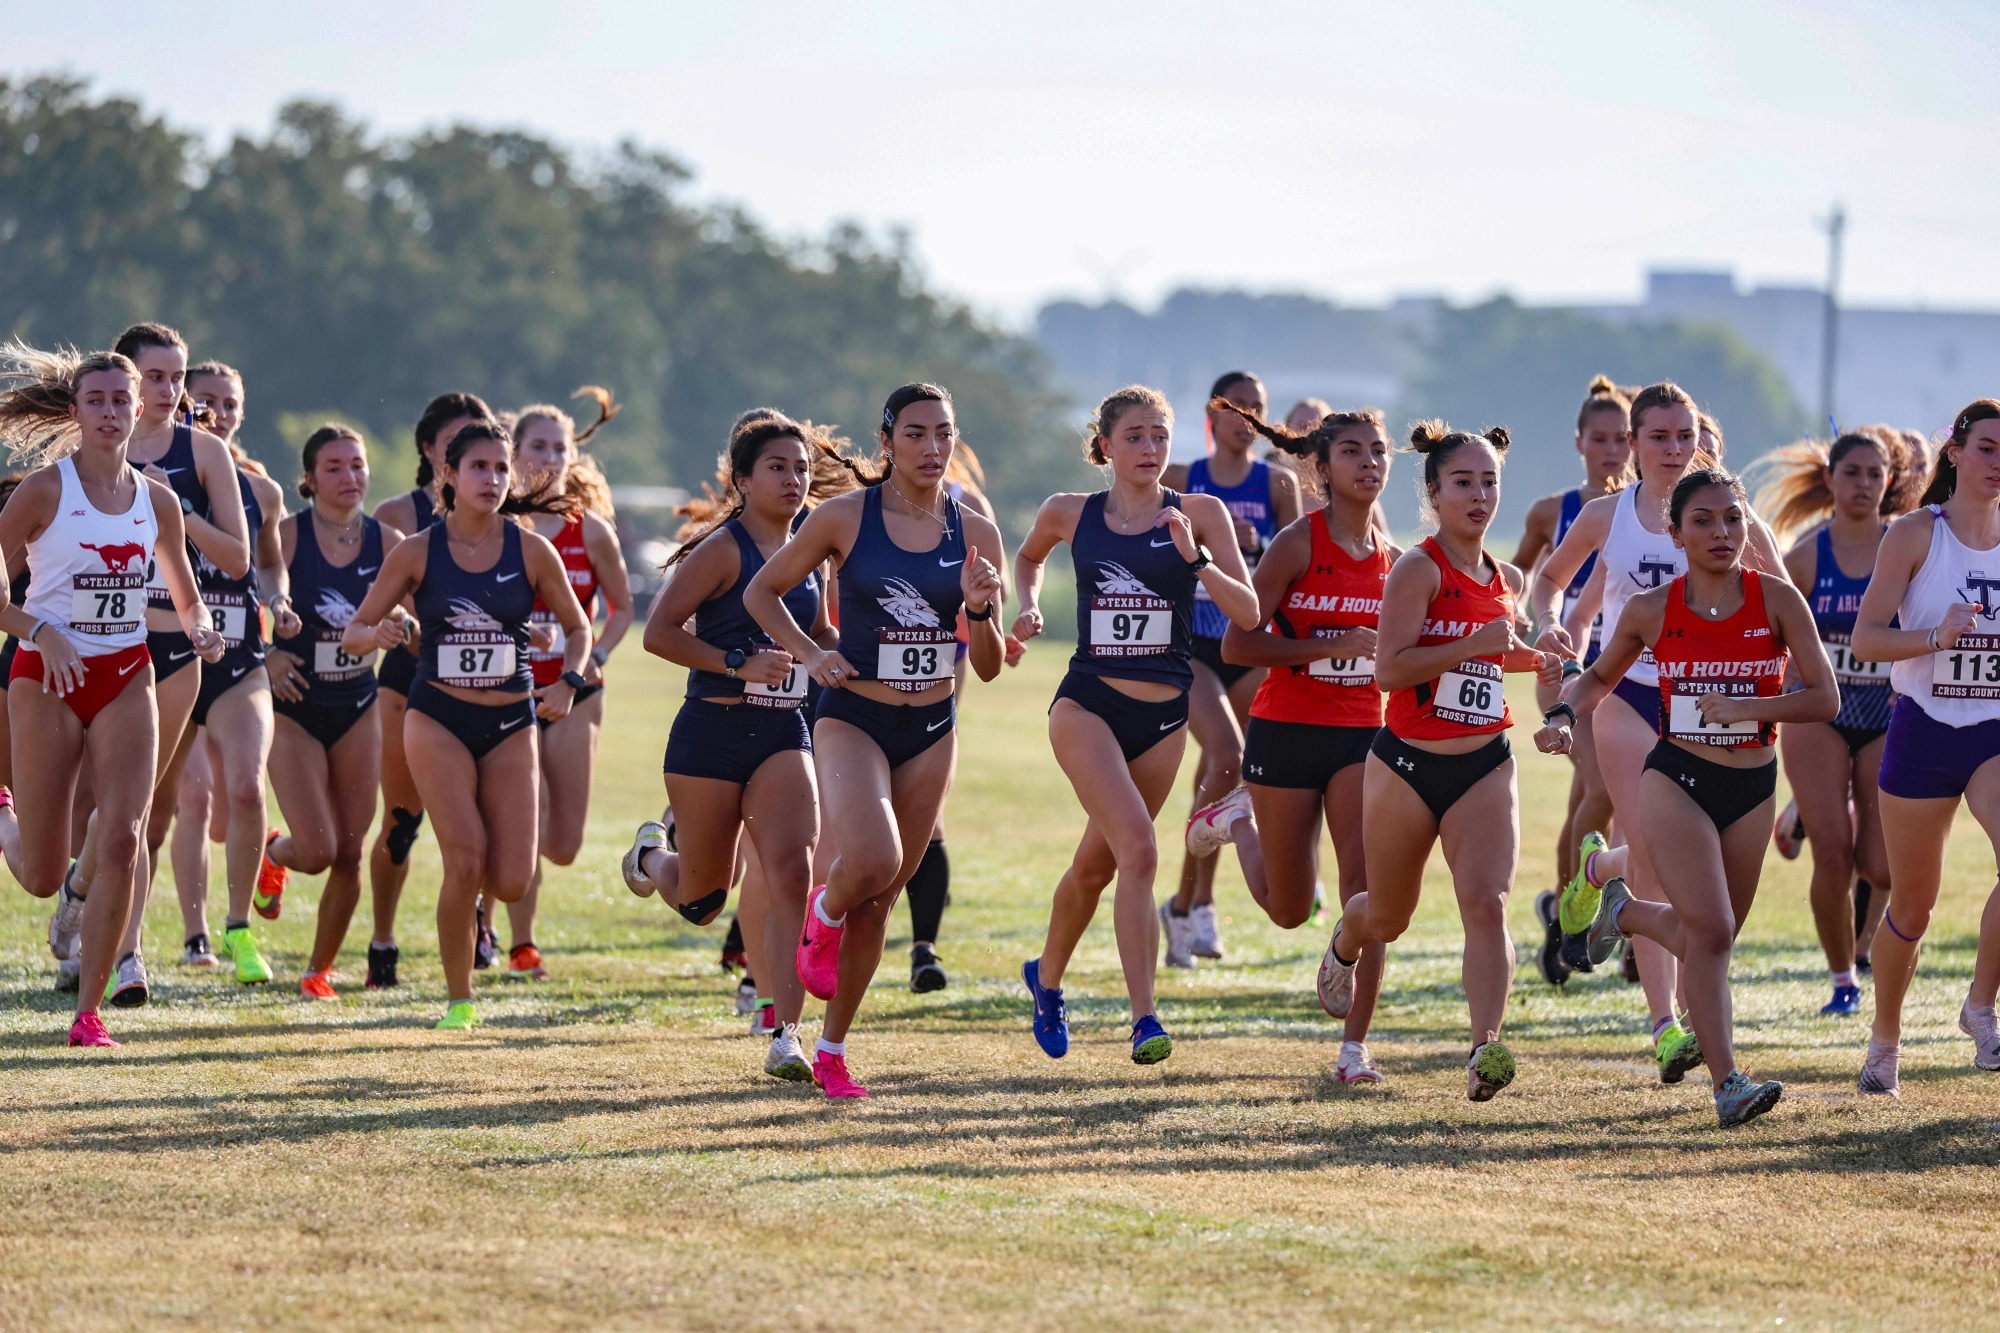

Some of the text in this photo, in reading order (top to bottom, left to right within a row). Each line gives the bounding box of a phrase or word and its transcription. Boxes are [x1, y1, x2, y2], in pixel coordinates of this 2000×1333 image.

[89, 577, 121, 587] TEXAS
[124, 576, 142, 587] A&M
[148, 590, 171, 600] NTRY
[202, 592, 243, 605] XAS A&M
[94, 592, 126, 619] 78
[1107, 598, 1141, 608] TEXAS
[1146, 598, 1168, 608] A&M
[1288, 592, 1340, 612] SAM
[1817, 595, 1832, 613] UT
[75, 622, 137, 634] CROSS COUNTRY
[1112, 613, 1150, 641] 97
[1753, 628, 1770, 637] USA
[454, 633, 486, 643] TEXAS
[897, 631, 931, 642] TEXAS
[935, 631, 954, 641] A&M
[1096, 646, 1168, 656] CROSS COUNTRY
[460, 648, 494, 673] 87
[902, 647, 937, 676] 93
[1658, 655, 1785, 678] AM HOUSTON
[1460, 661, 1488, 676] TEXAS
[1949, 653, 2000, 683] 113
[1342, 676, 1372, 687] COUNTRY
[1459, 679, 1491, 710] 66
[1689, 683, 1726, 694] TEXAS
[1731, 683, 1754, 694] A&M
[1938, 686, 2000, 698] CROSS COUNT
[746, 695, 773, 707] CROSS
[1436, 708, 1466, 723] CROSS
[1710, 735, 1754, 746] COUNTRY
